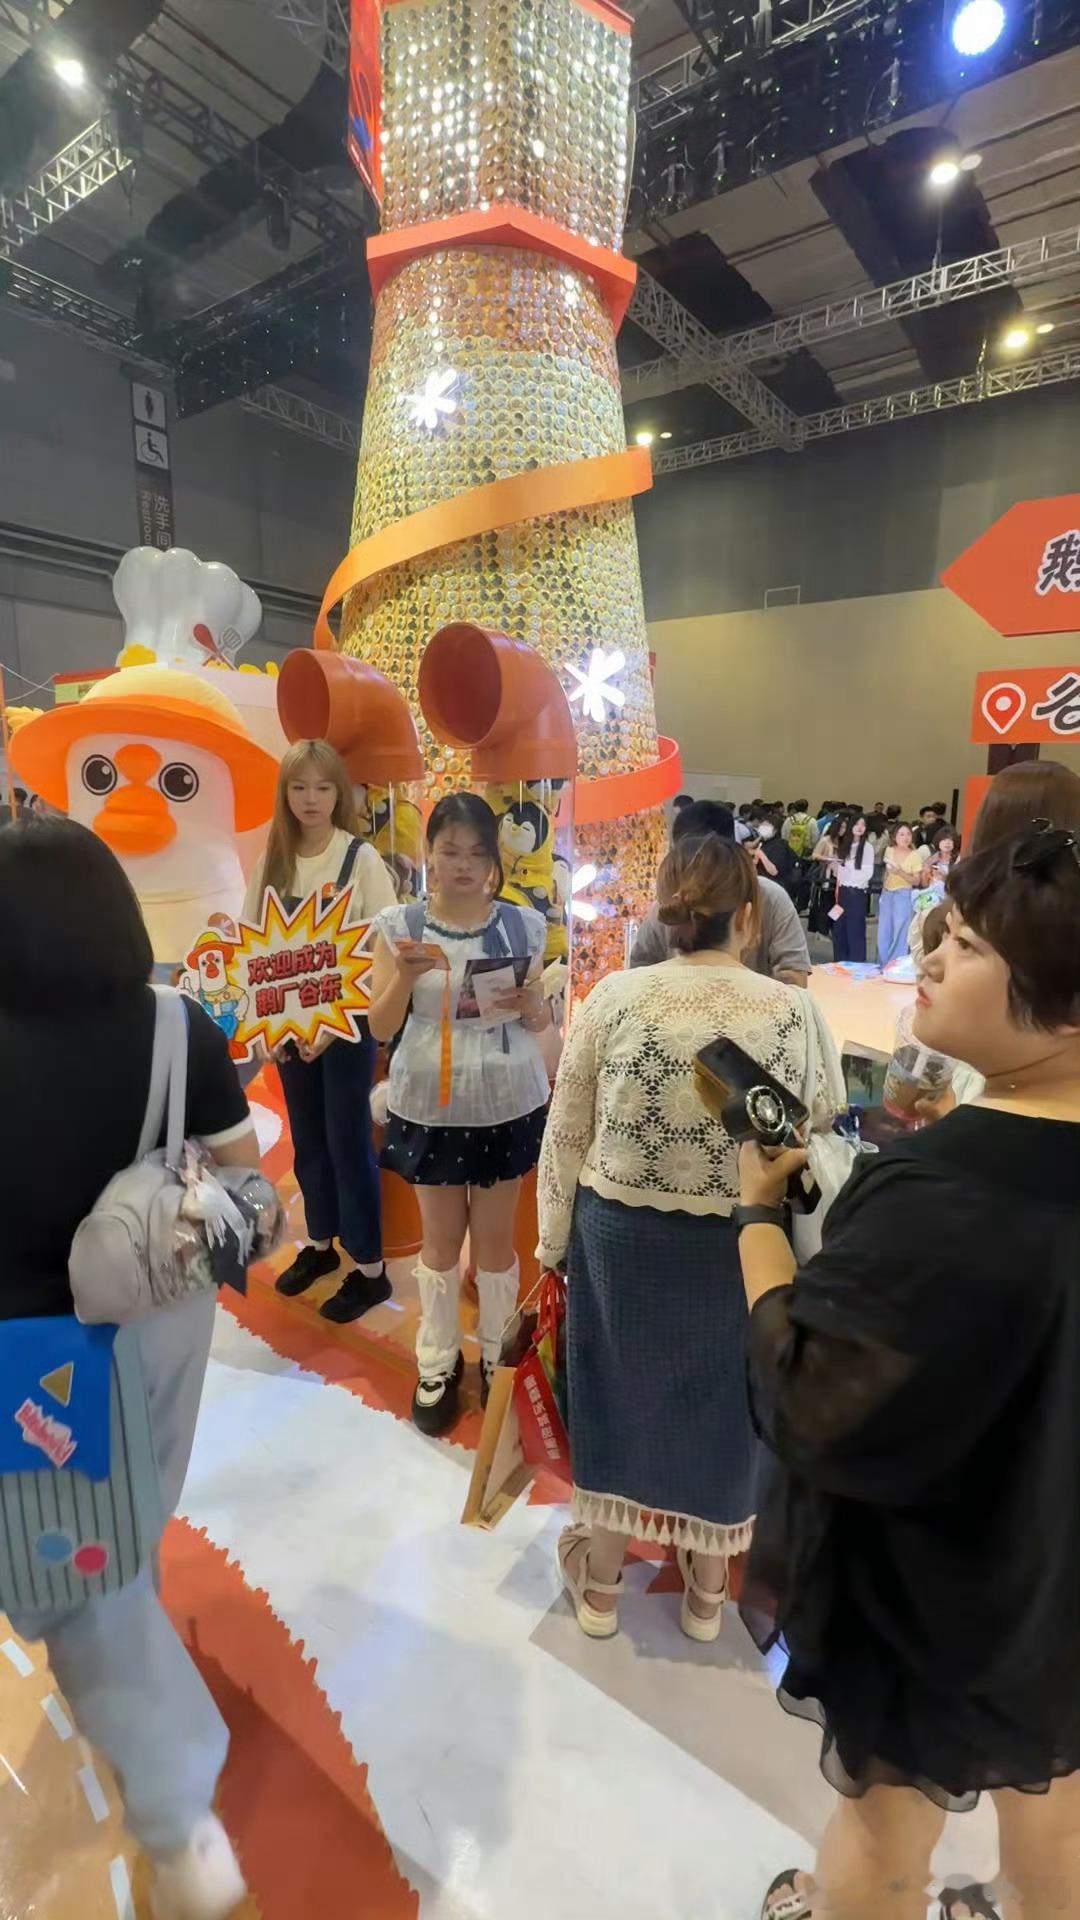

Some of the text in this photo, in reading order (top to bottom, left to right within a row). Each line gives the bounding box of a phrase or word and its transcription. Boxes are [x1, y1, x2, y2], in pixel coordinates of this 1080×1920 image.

[154, 495, 171, 548] 洗手间
[247, 940, 337, 985] 欢迎成为
[255, 973, 343, 1017] 鹅厂谷东
